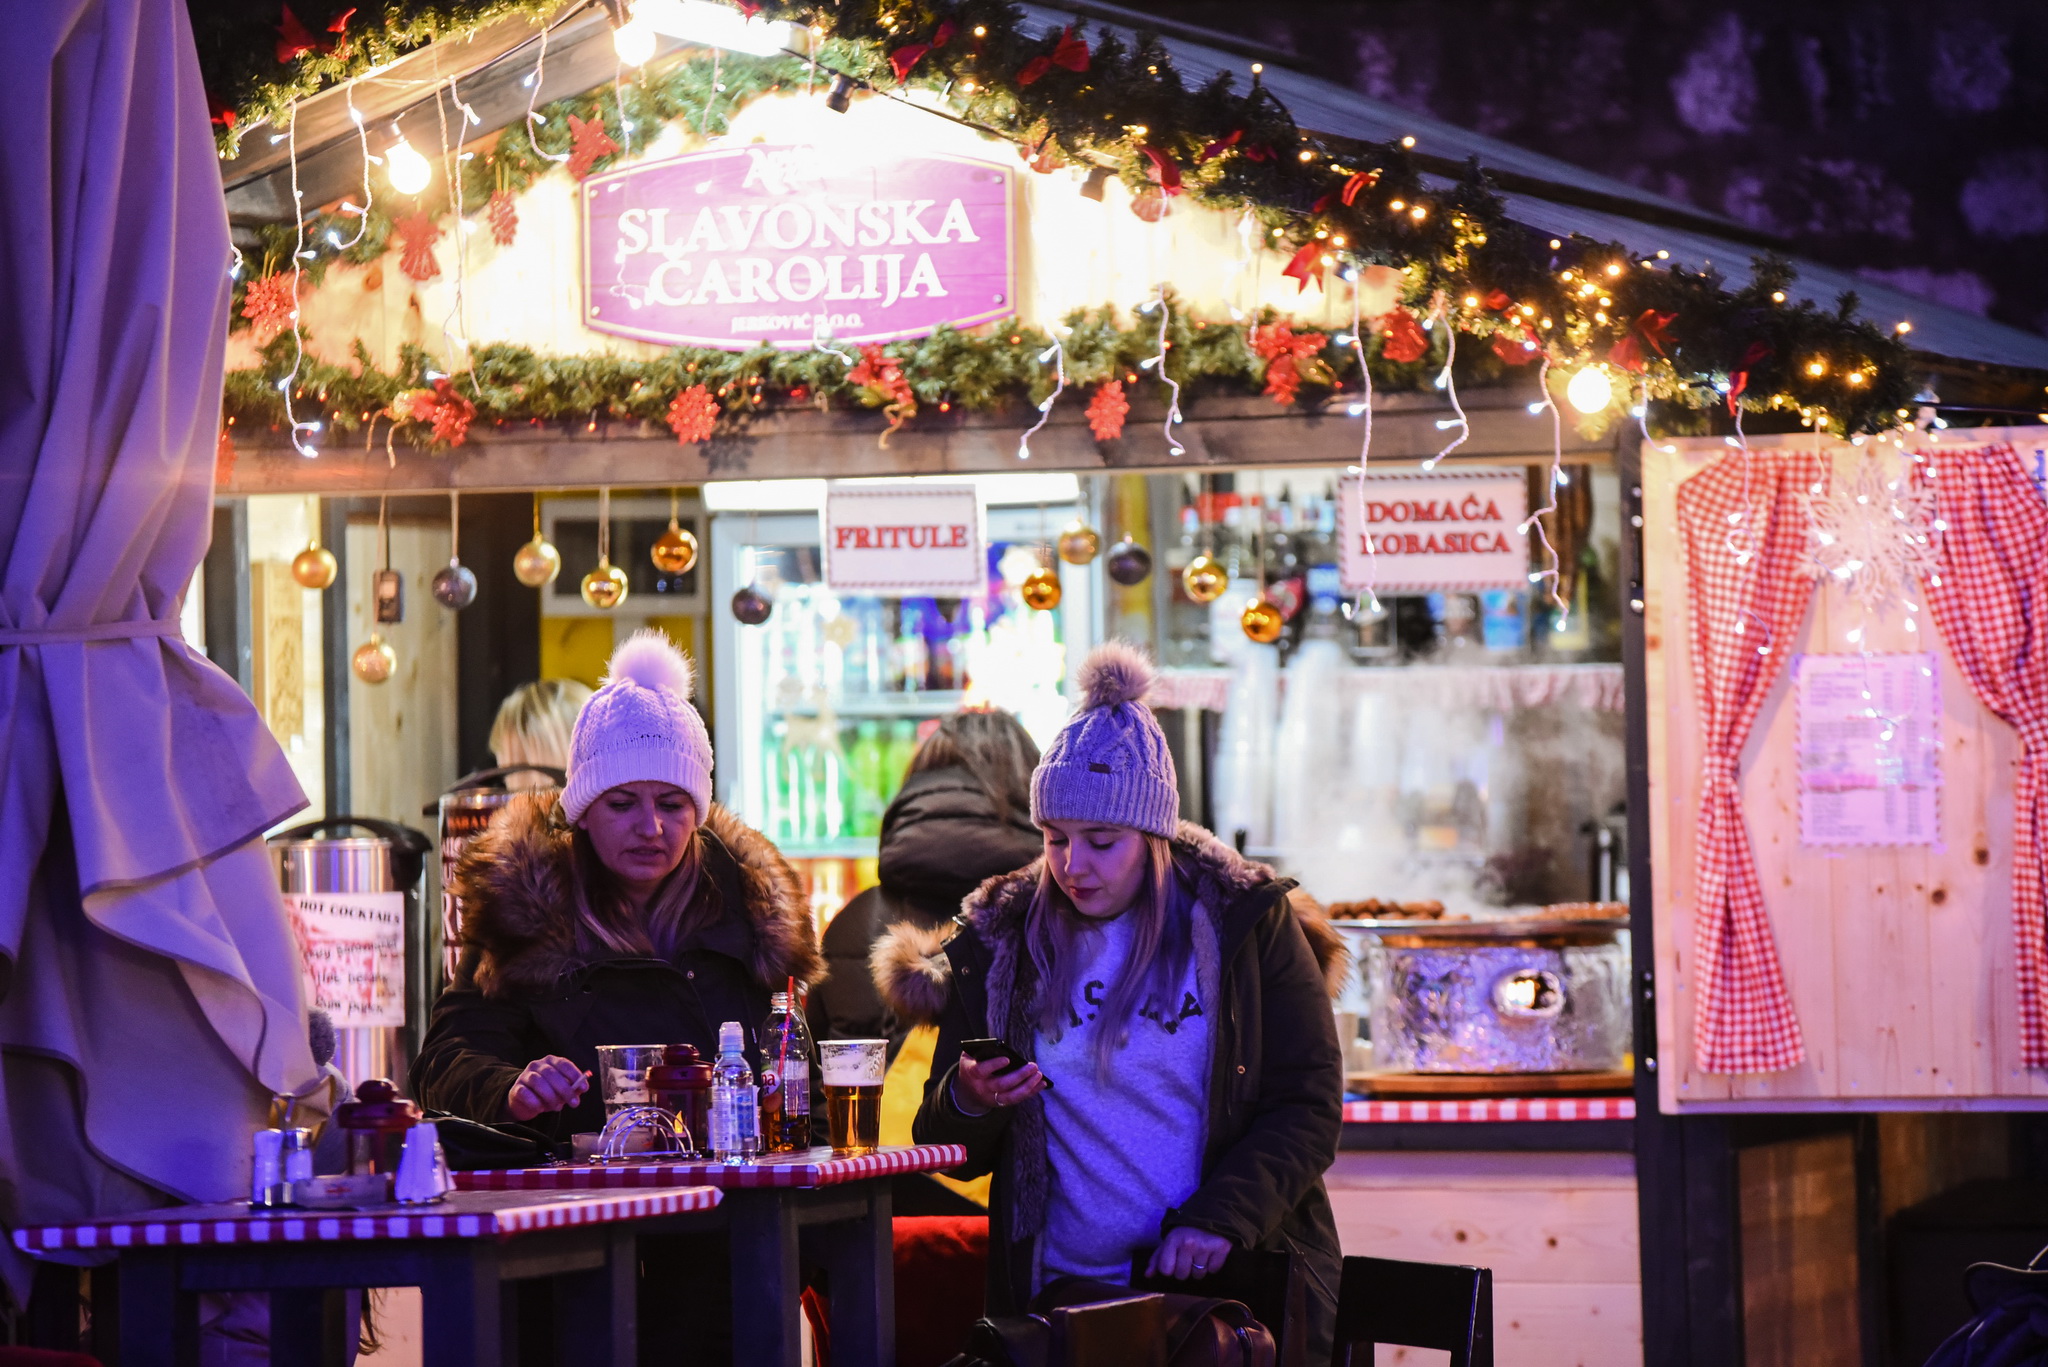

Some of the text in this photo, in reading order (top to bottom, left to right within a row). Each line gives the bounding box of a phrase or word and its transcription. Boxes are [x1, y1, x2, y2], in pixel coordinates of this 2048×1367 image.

[618, 198, 981, 255] SLAVONSKA
[648, 251, 949, 308] ČAROLIJA
[835, 525, 968, 549] FRITULE
[1360, 531, 1511, 555] KOBASICA
[300, 900, 400, 924] HOT COCKTAILS
